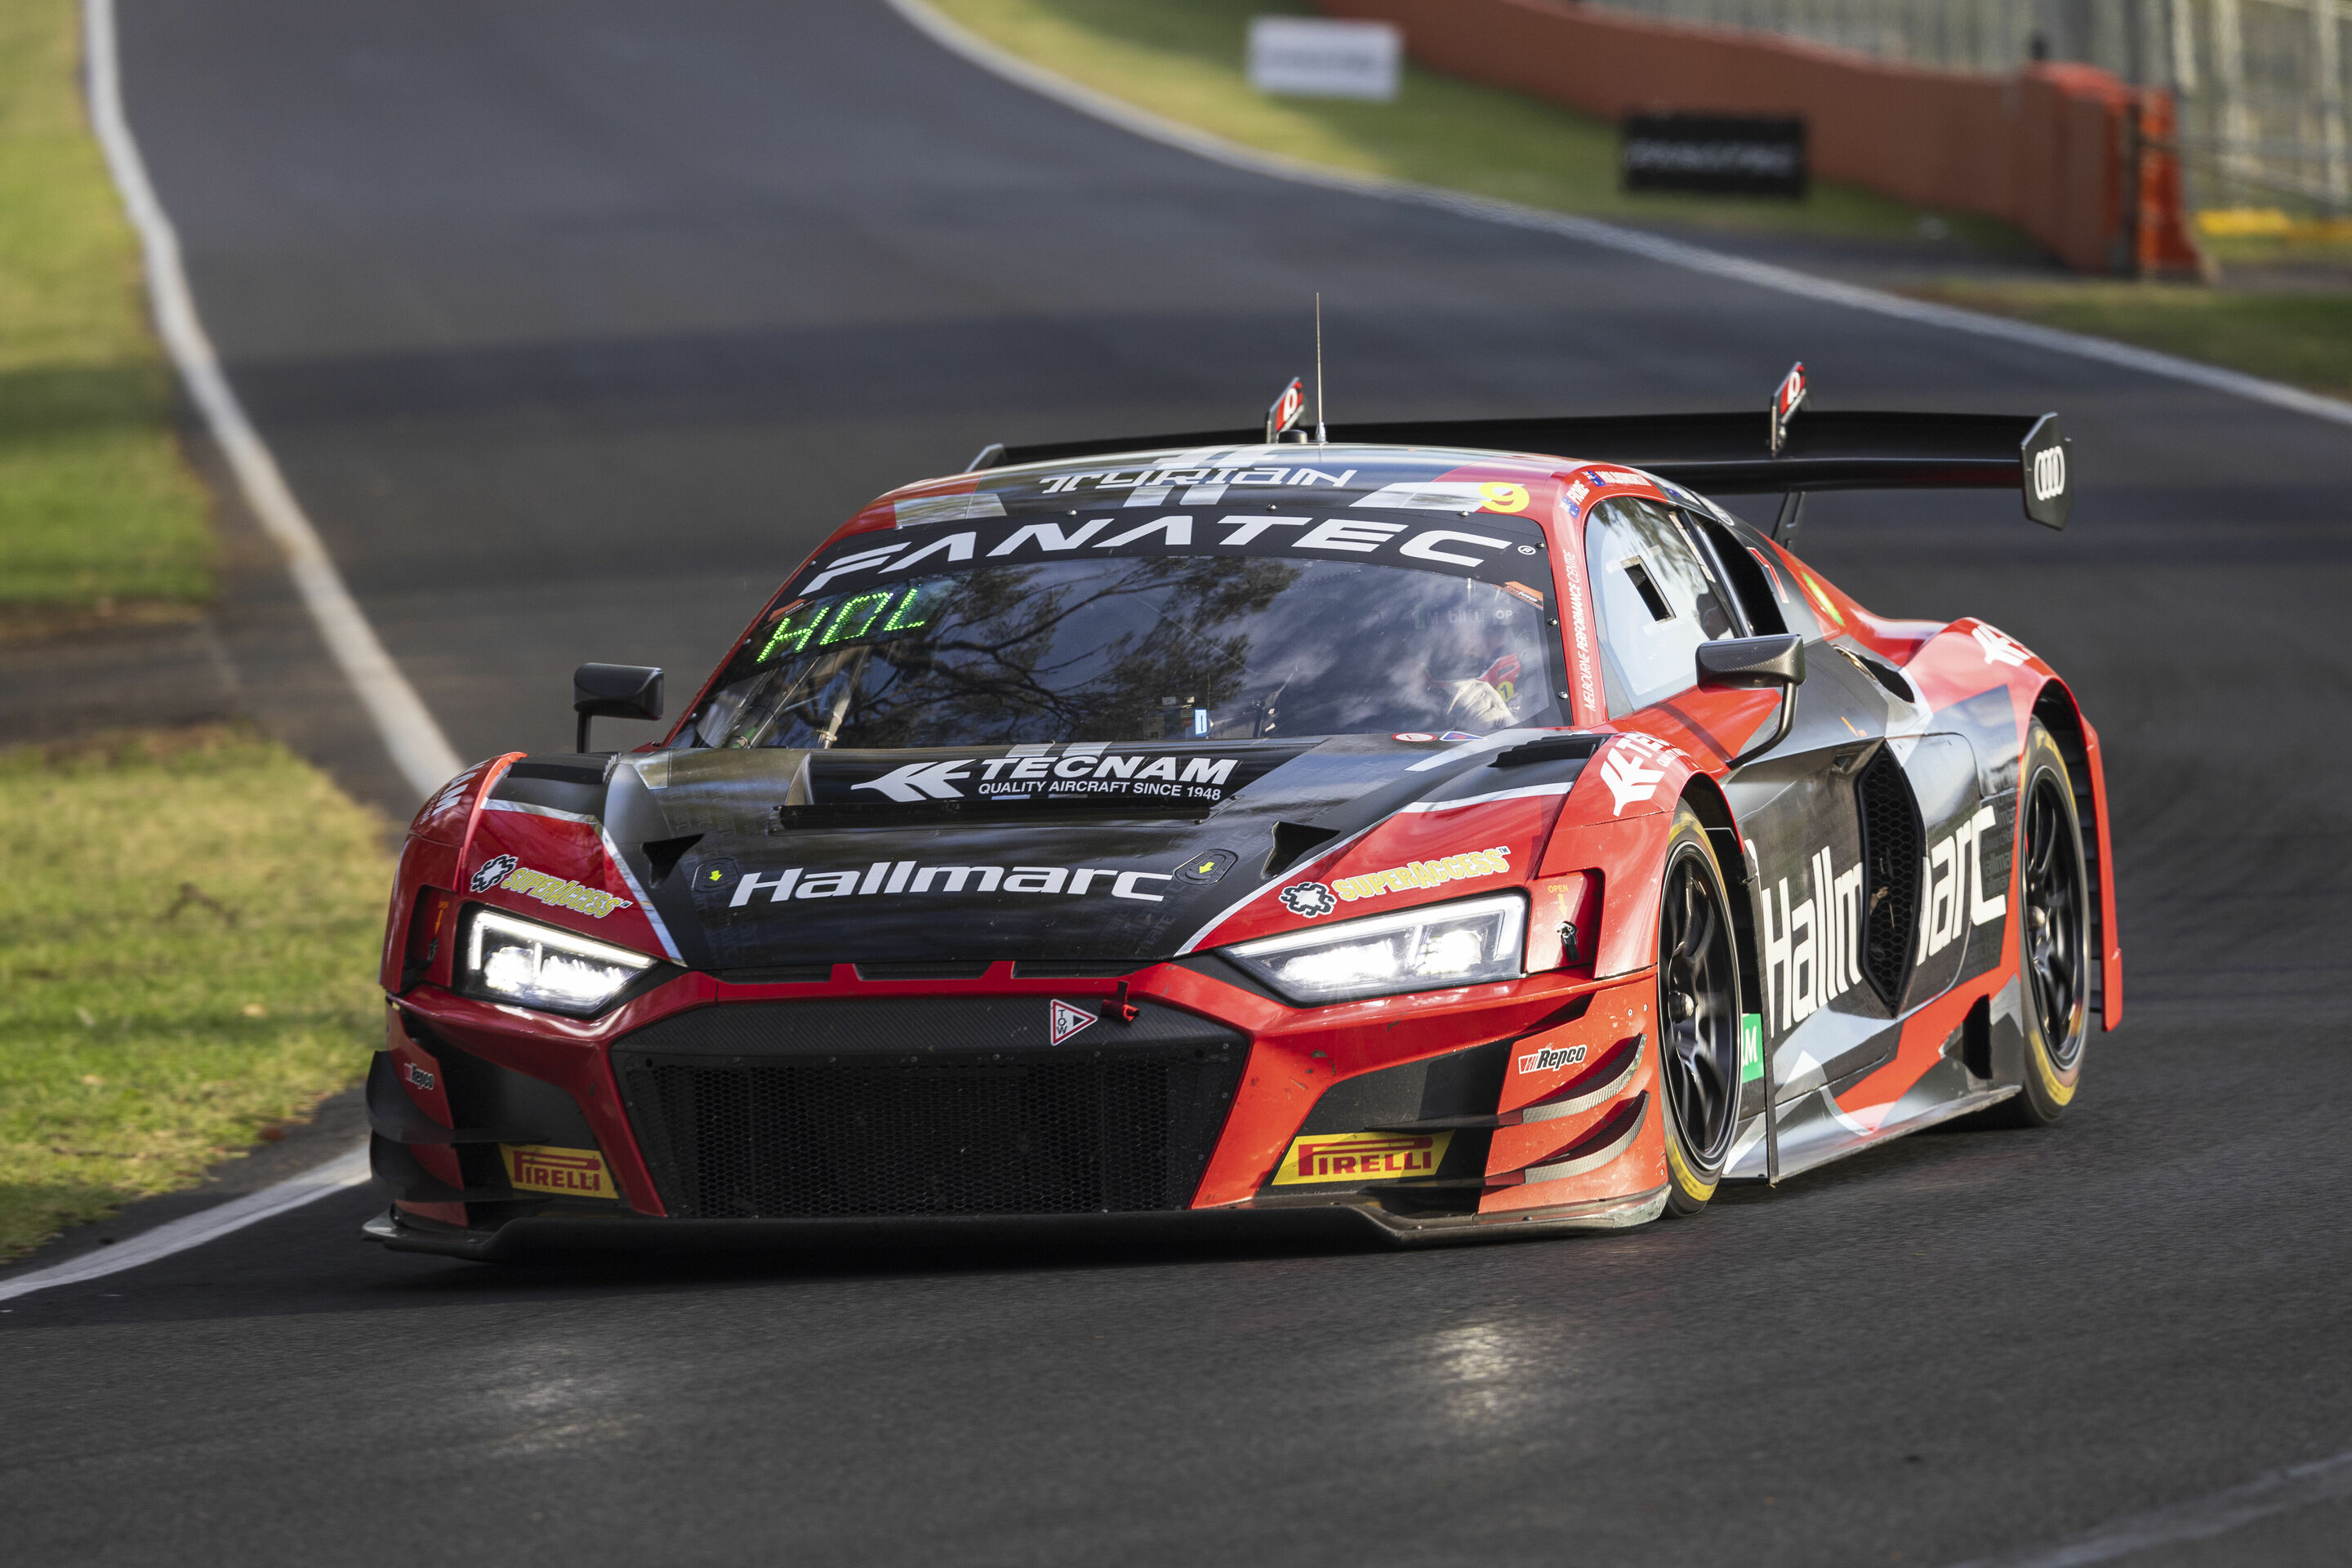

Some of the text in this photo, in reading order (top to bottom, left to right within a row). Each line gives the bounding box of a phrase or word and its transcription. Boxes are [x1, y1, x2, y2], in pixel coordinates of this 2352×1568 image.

[1479, 481, 1530, 513] 9
[798, 515, 1512, 596] FANATEC
[1563, 549, 1597, 712] MELBOURNE PERFORMANCE CENTRE
[980, 755, 1239, 786] TECNAM
[978, 781, 1222, 801] QUALITY AIRCRAFT SINCE 1948
[728, 861, 1174, 908] Hallmarc
[1548, 884, 1570, 893] OPEN
[1057, 1009, 1068, 1035] TOW
[1536, 1044, 1588, 1071] Repco
[514, 1150, 602, 1192] PIRELLI
[1298, 1136, 1434, 1177] PIRELLI
